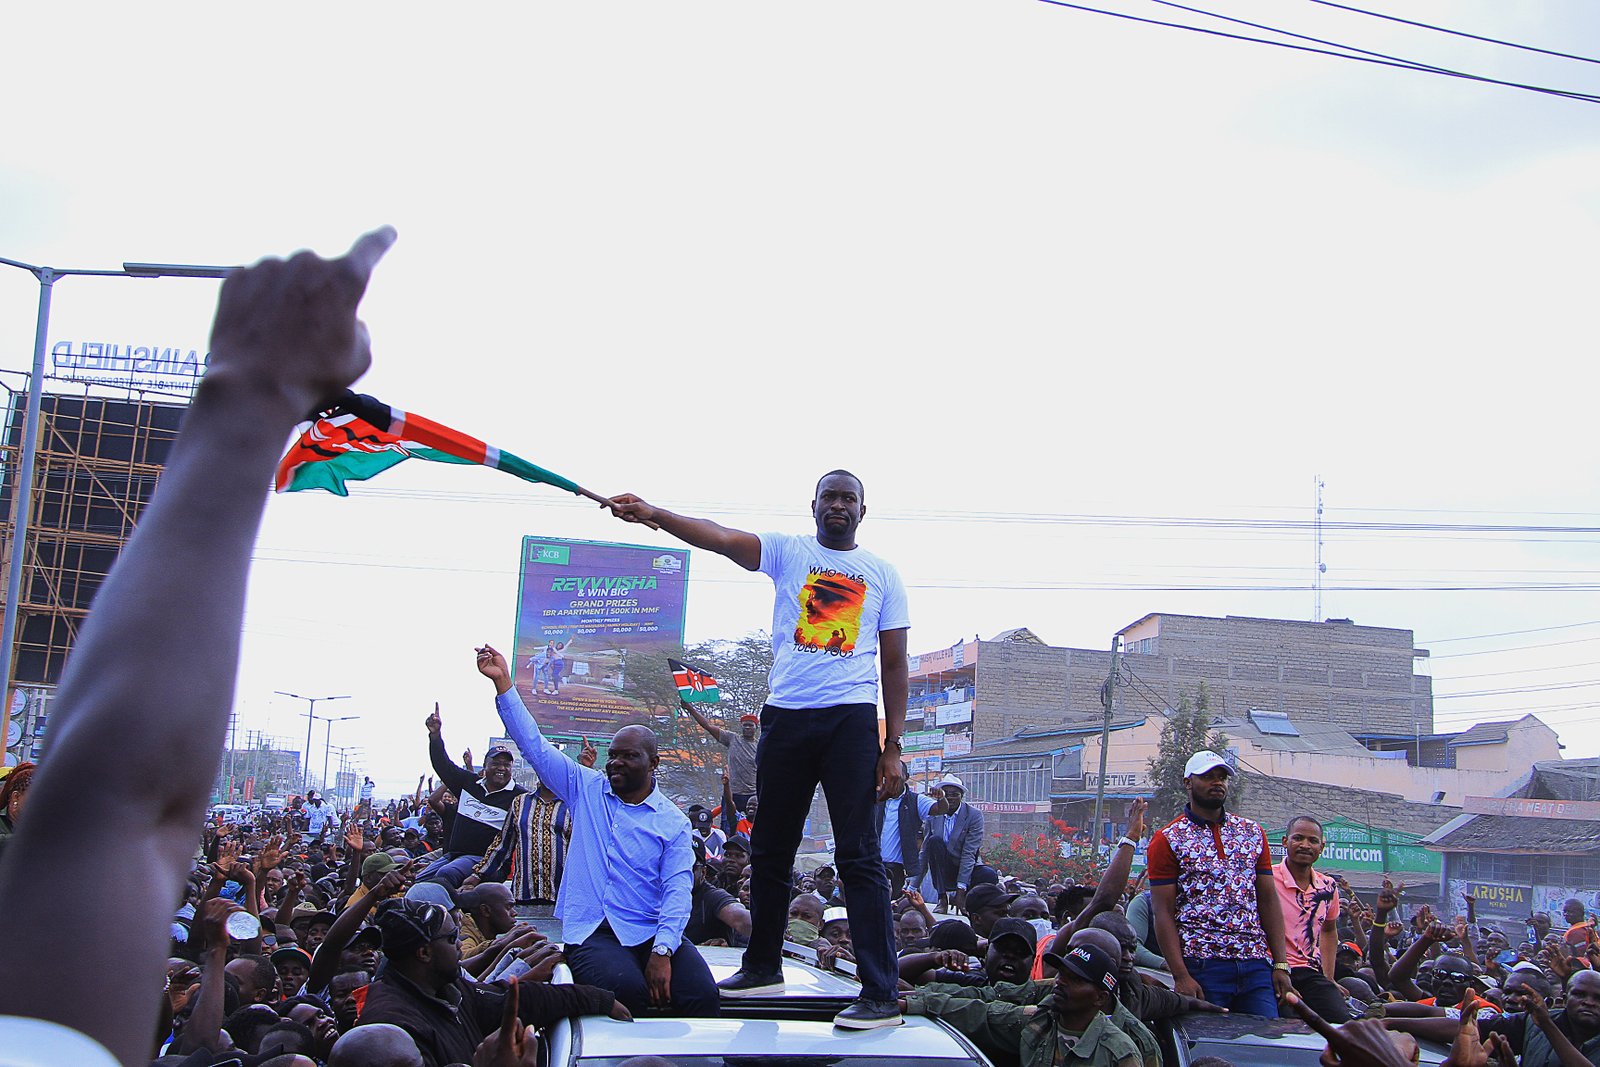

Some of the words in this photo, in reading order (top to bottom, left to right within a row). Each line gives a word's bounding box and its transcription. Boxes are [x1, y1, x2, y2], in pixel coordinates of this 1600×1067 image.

[542, 550, 560, 559] KCB
[809, 565, 837, 578] WHO
[587, 588, 608, 597] WIN
[610, 587, 629, 596] BIG
[569, 600, 604, 609] GRAND
[605, 598, 638, 607] PRIZES
[556, 608, 605, 616] APARTMENT
[610, 607, 631, 615] 500K
[631, 606, 640, 614] IN
[640, 606, 660, 614] MMF
[792, 643, 818, 654] TOLD
[823, 645, 854, 658] YOU?
[993, 803, 1023, 812] FASHIONS
[1526, 802, 1555, 813] MEAT
[1321, 844, 1383, 862] afaricom
[1473, 885, 1524, 903] ARUSHA
